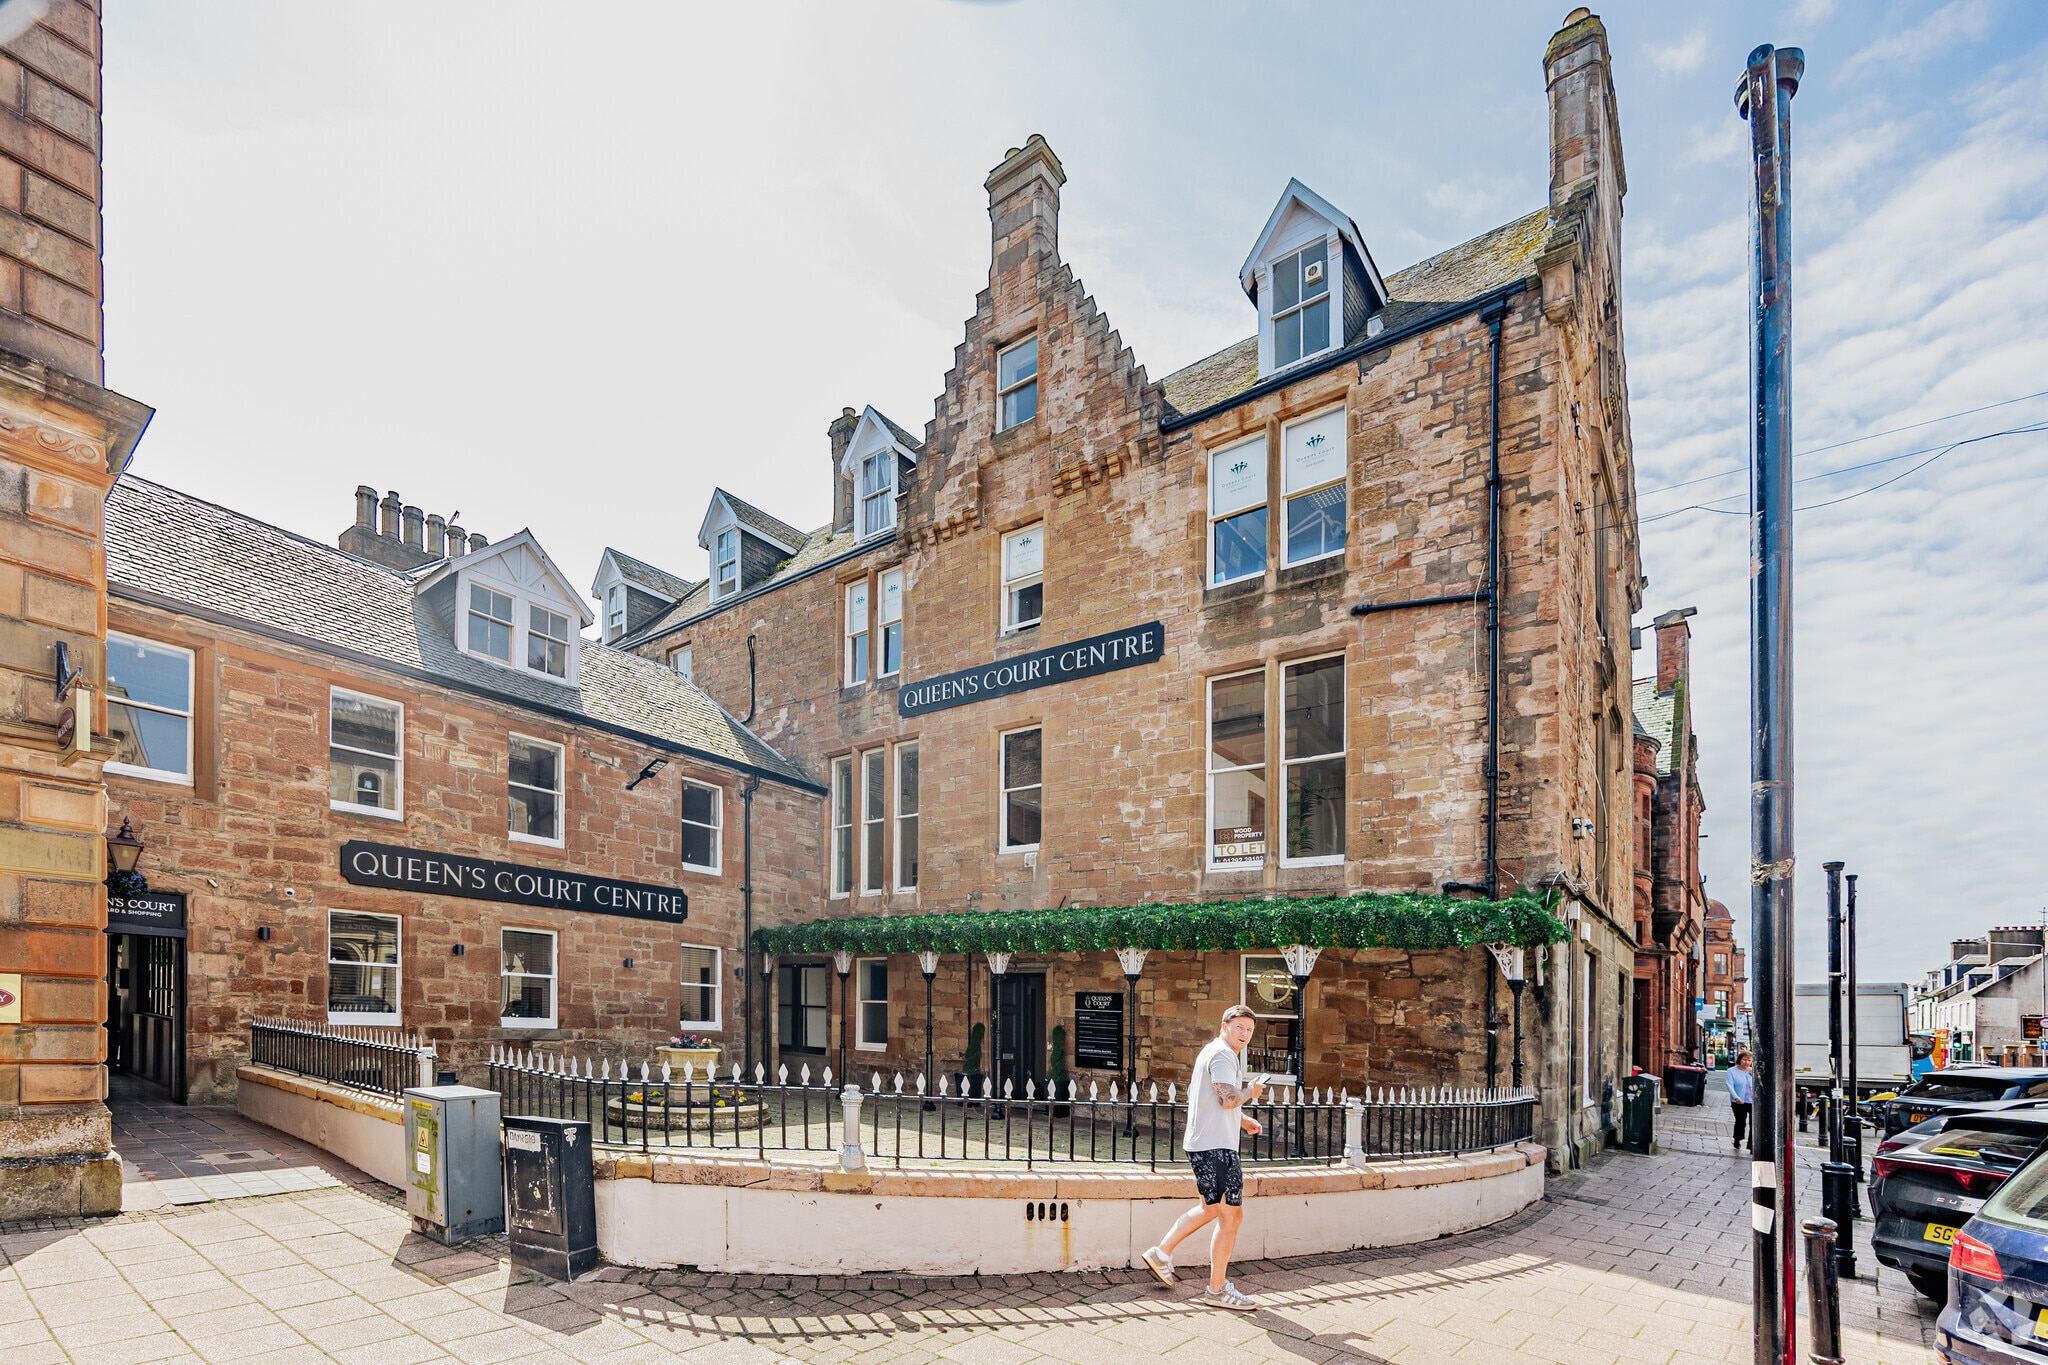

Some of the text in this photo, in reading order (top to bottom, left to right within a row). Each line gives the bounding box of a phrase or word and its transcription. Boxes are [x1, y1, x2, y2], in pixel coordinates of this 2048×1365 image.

[904, 631, 1155, 709] QUEEN'S COURT CENTRE
[1217, 842, 1264, 856] TO LET
[352, 851, 683, 916] QUEEN'S COURT CENTRE
[128, 899, 177, 912] COURT
[1932, 1226, 1957, 1243] SG
